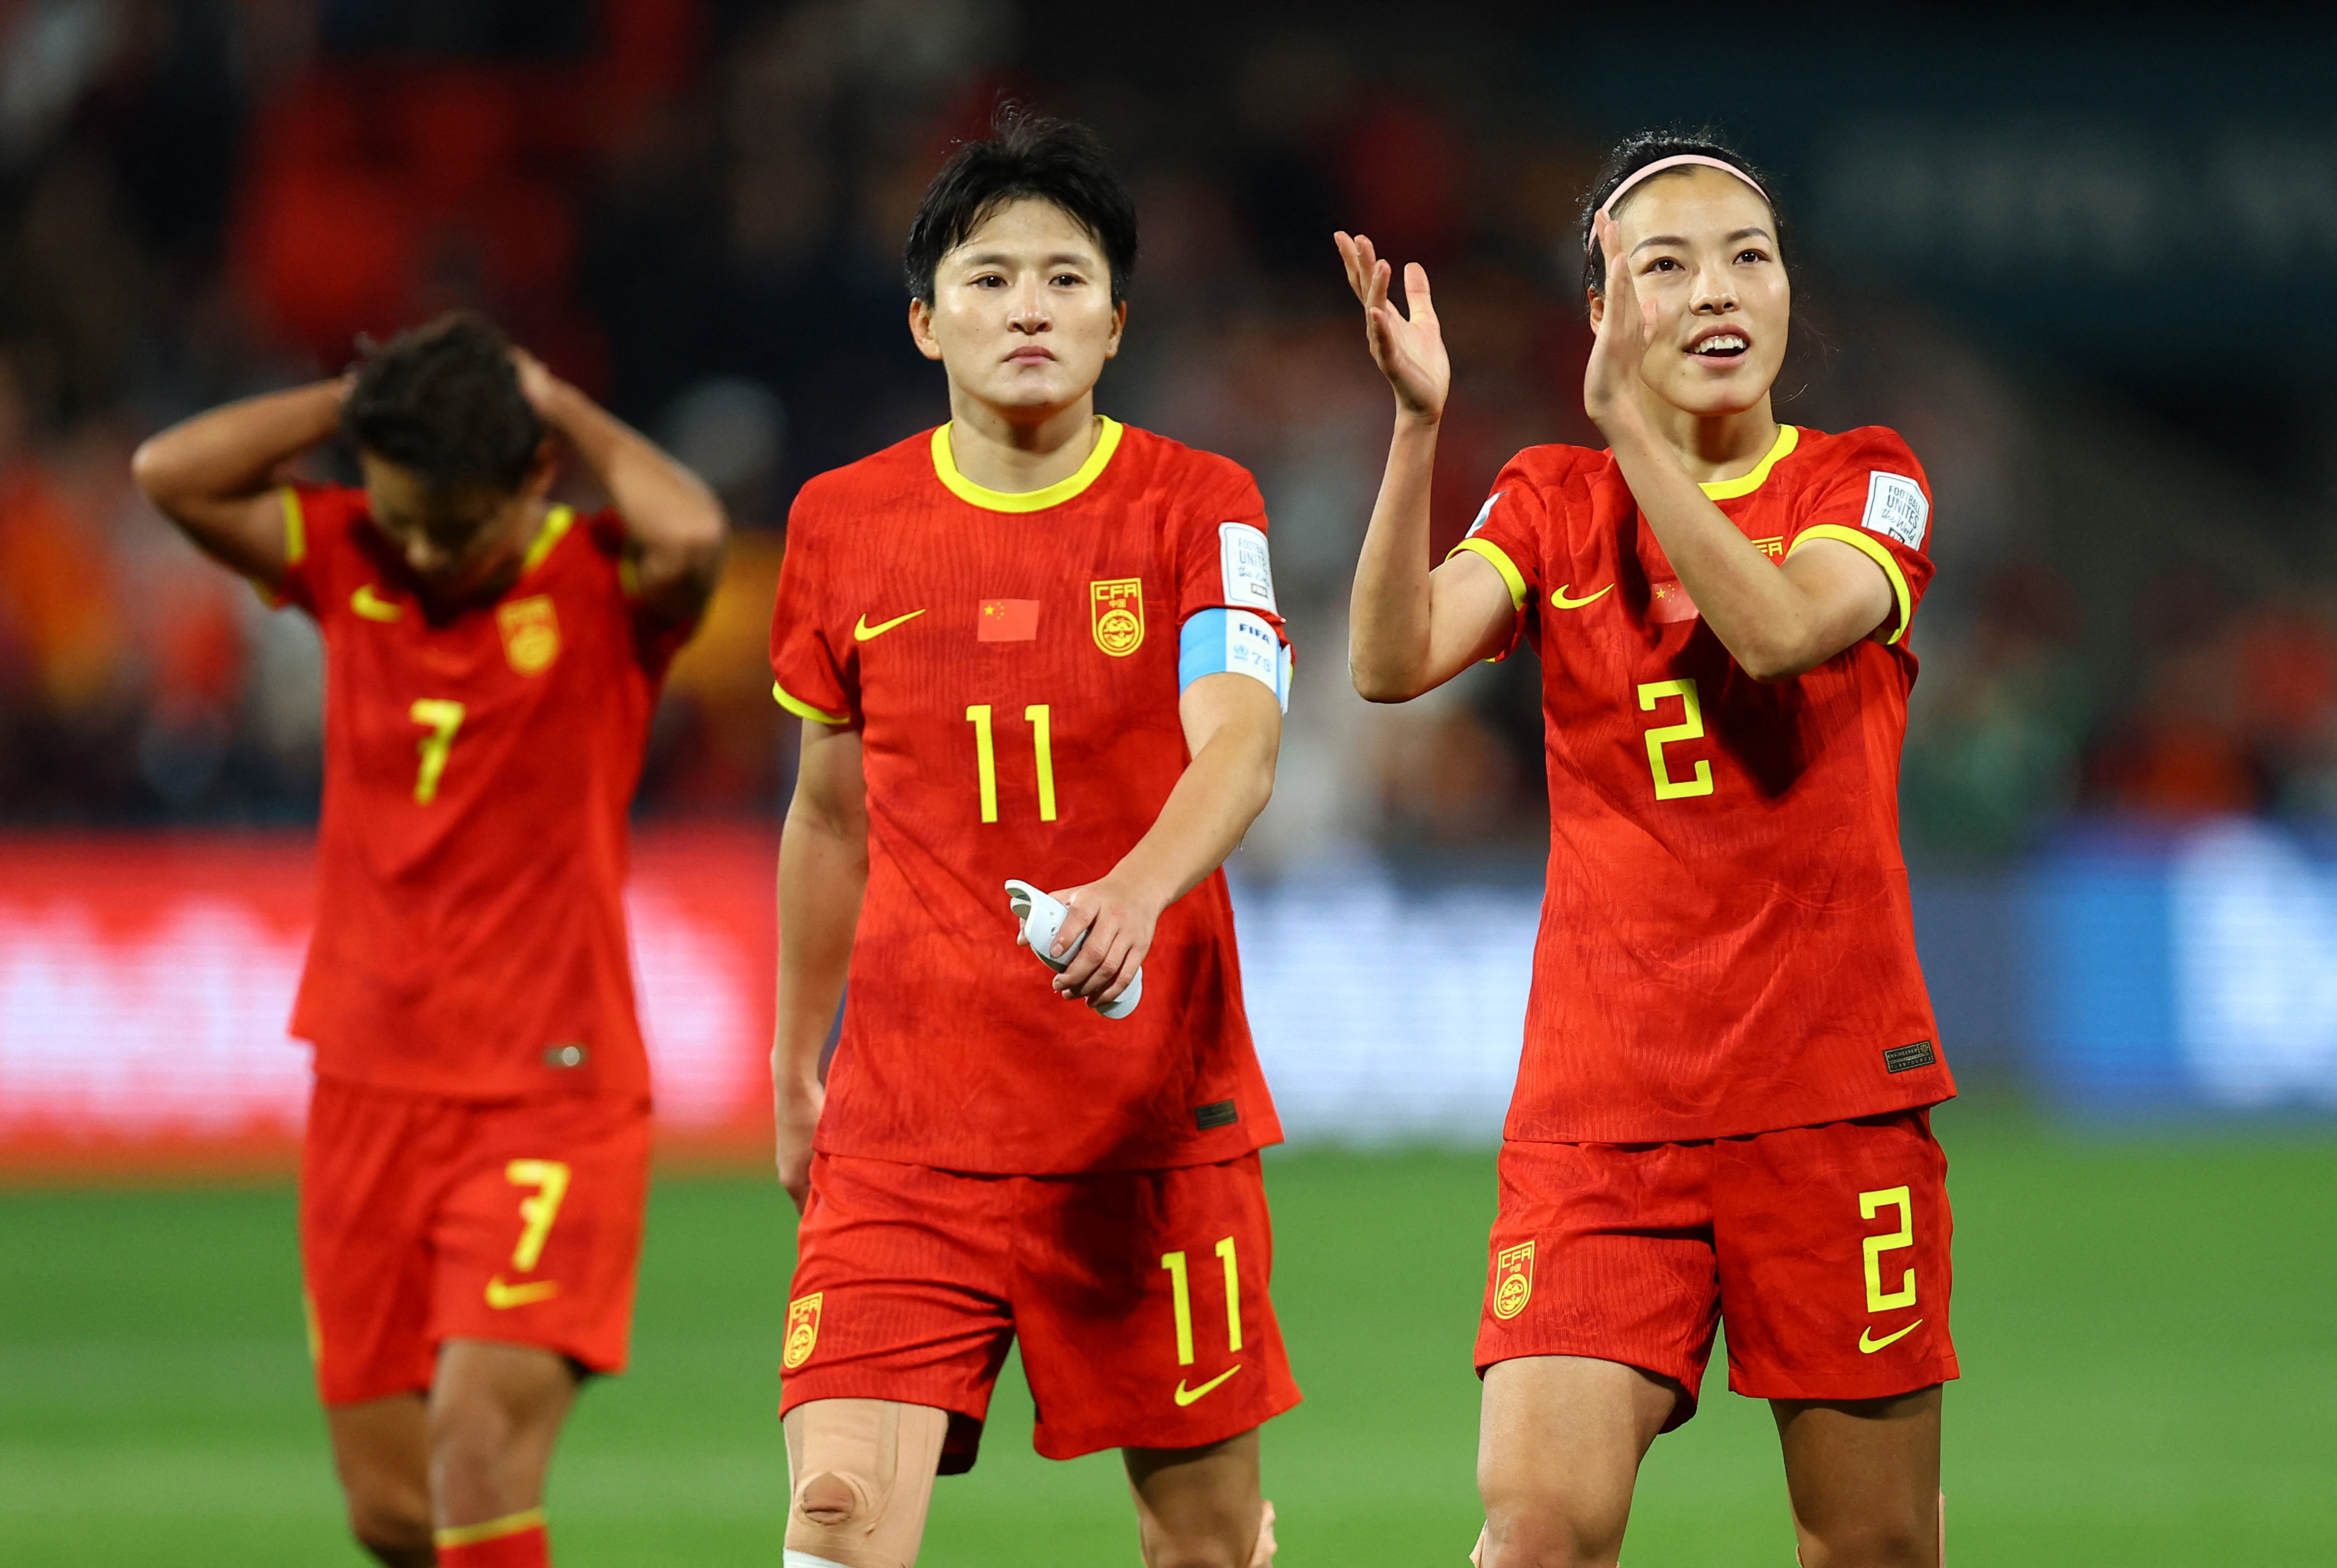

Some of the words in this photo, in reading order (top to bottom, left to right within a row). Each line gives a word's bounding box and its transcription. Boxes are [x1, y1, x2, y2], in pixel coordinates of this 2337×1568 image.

[1887, 494, 1919, 529] UNITES
[1889, 485, 1921, 516] FOOTBALL
[1882, 509, 1896, 523] the
[1896, 516, 1916, 544] World
[1096, 583, 1138, 600] CFA
[1239, 623, 1270, 645] FIFA
[409, 697, 466, 807] 7
[1637, 677, 1714, 801] 2
[965, 704, 1057, 823] 11
[505, 1158, 571, 1272] 7
[1501, 1246, 1531, 1268] CFA
[1859, 1185, 1917, 1313] 2
[792, 1298, 819, 1319] CFA
[1161, 1235, 1243, 1366] 11
